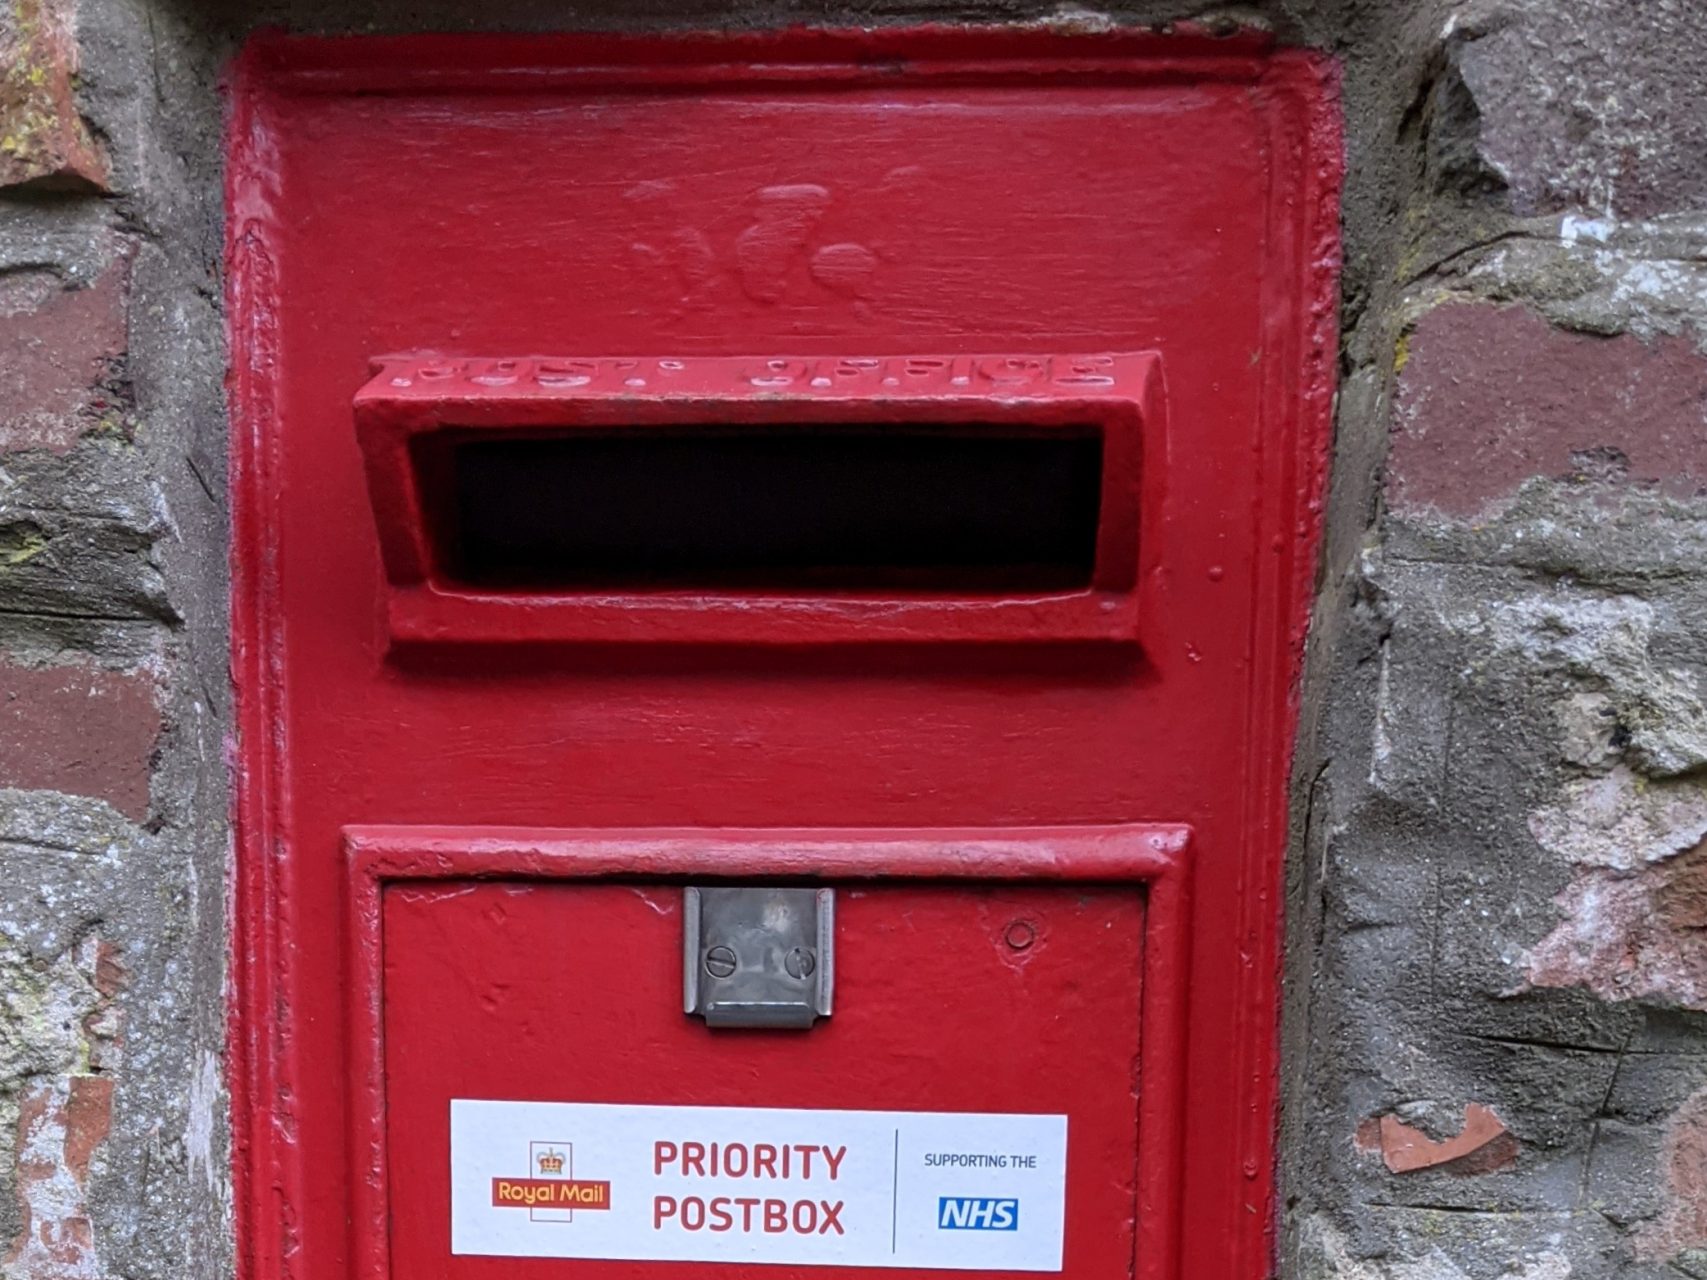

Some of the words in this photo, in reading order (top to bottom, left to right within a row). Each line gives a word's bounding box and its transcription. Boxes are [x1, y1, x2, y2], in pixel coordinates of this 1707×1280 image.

[748, 355, 1116, 388] OFFICE
[655, 1141, 846, 1180] PRIORITY
[925, 1153, 1007, 1168] SUPPORTING
[1010, 1155, 1037, 1168] THE
[498, 1181, 555, 1205] Royal
[560, 1183, 604, 1203] Mail
[654, 1196, 844, 1235] POSTBOX
[941, 1199, 1015, 1228] NHS
